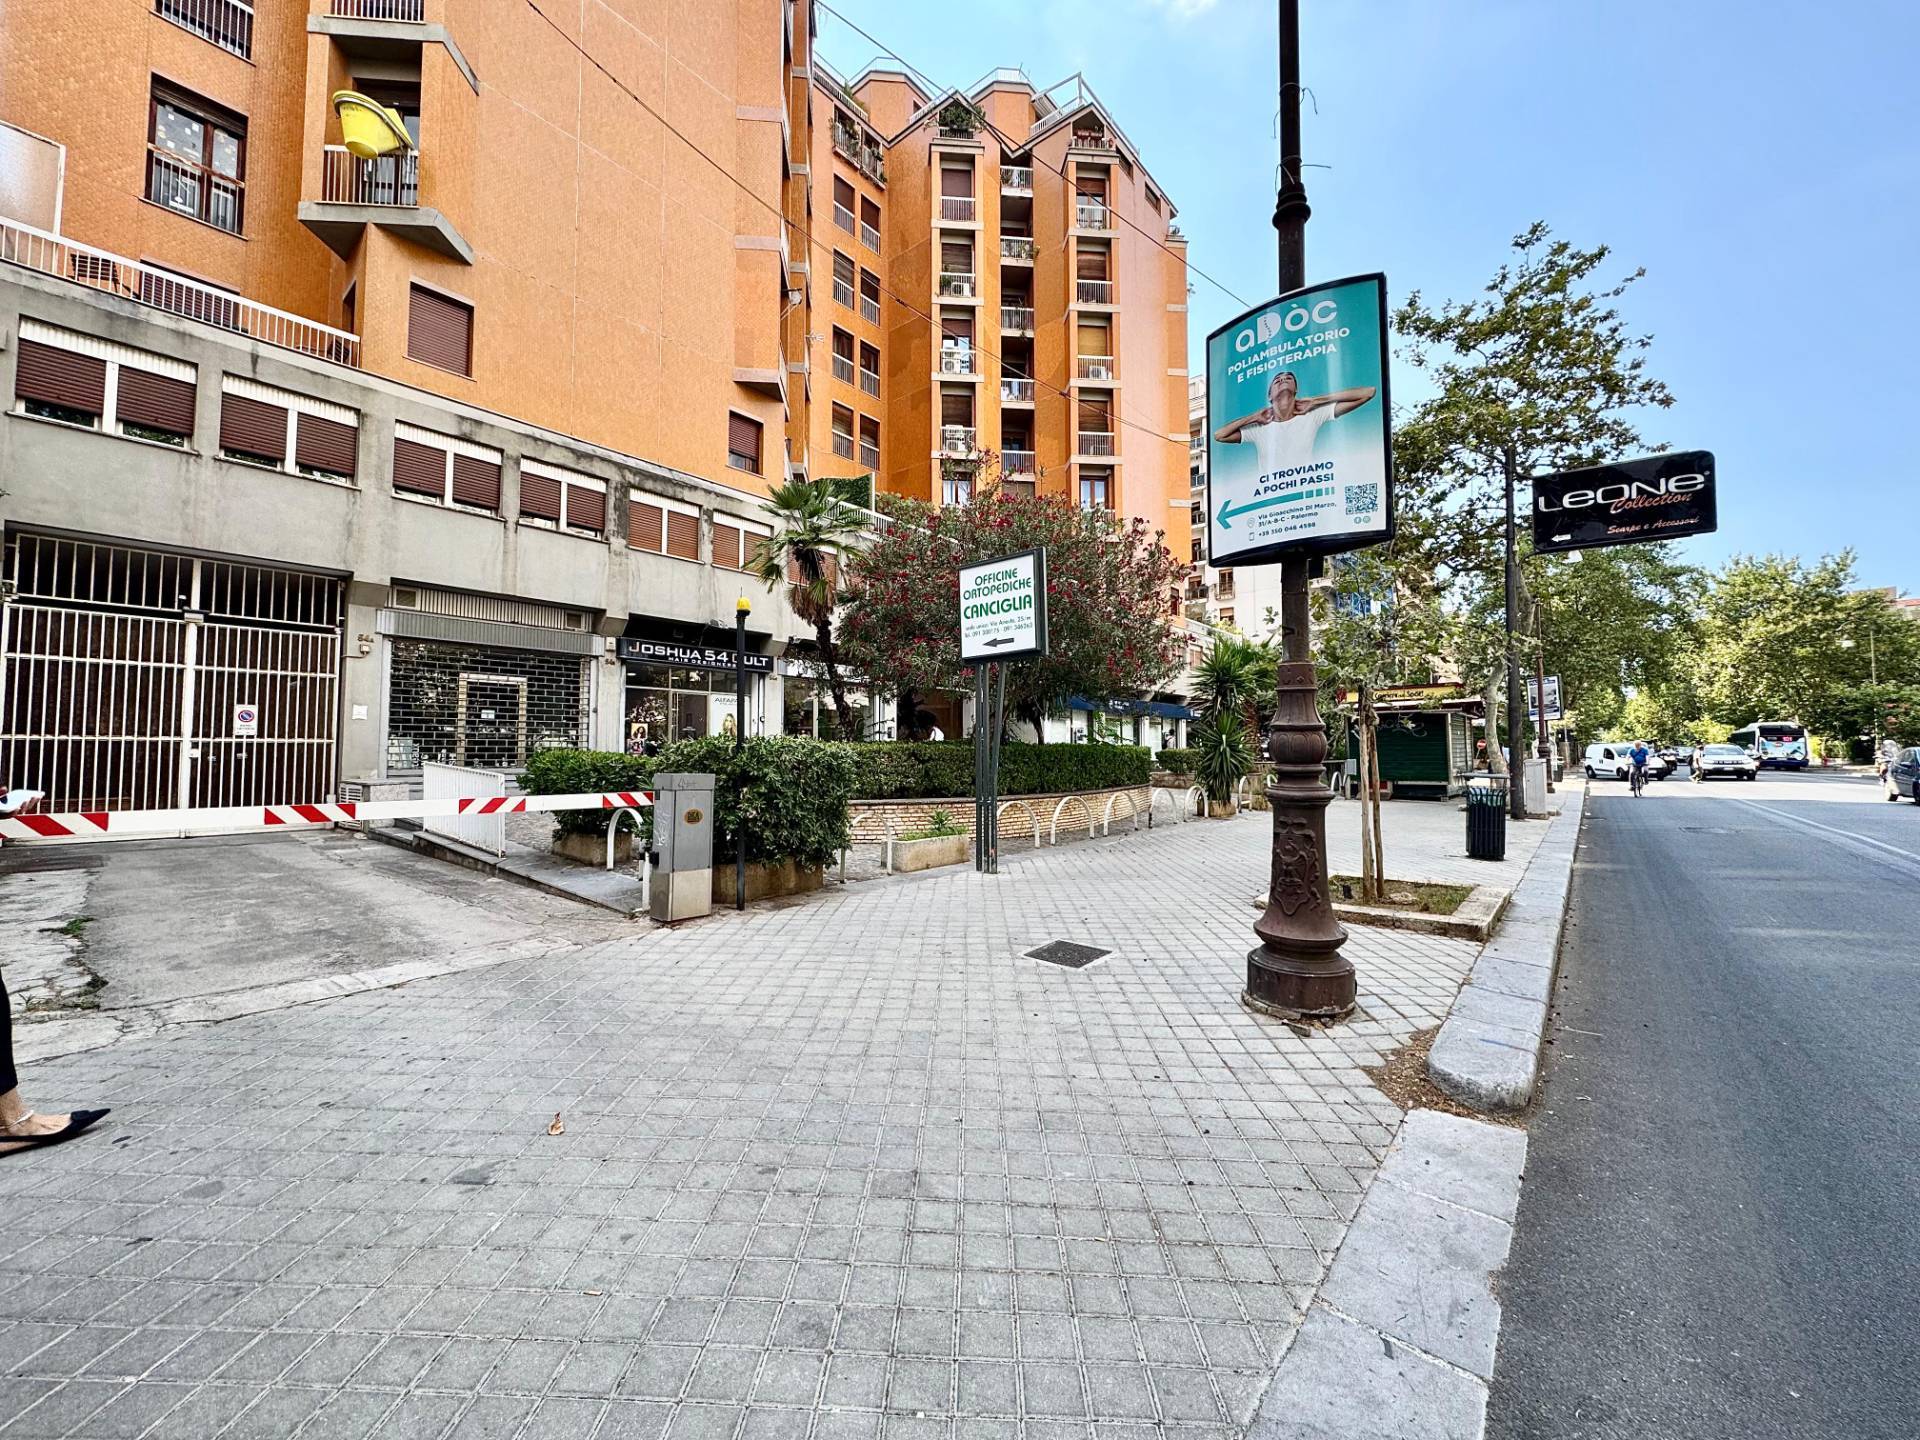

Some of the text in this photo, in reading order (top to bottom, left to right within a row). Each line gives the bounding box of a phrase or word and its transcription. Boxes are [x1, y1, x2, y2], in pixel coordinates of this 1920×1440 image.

[1228, 328, 1350, 376] POLIAMBULATORIO
[1237, 344, 1337, 383] E FISIOTERAPIA
[1260, 461, 1333, 483] CI TROVIAMO
[1264, 480, 1297, 494] POCHI
[1300, 473, 1334, 486] PASSI
[1609, 491, 1693, 514] Collection
[1291, 512, 1319, 520] Palermo
[975, 568, 1018, 586] OFFICINE
[963, 577, 1032, 600] ORTOPEDICHE
[963, 594, 1032, 619] CANCIGLIA
[629, 641, 701, 660] JOSHUA
[704, 650, 729, 663] 54
